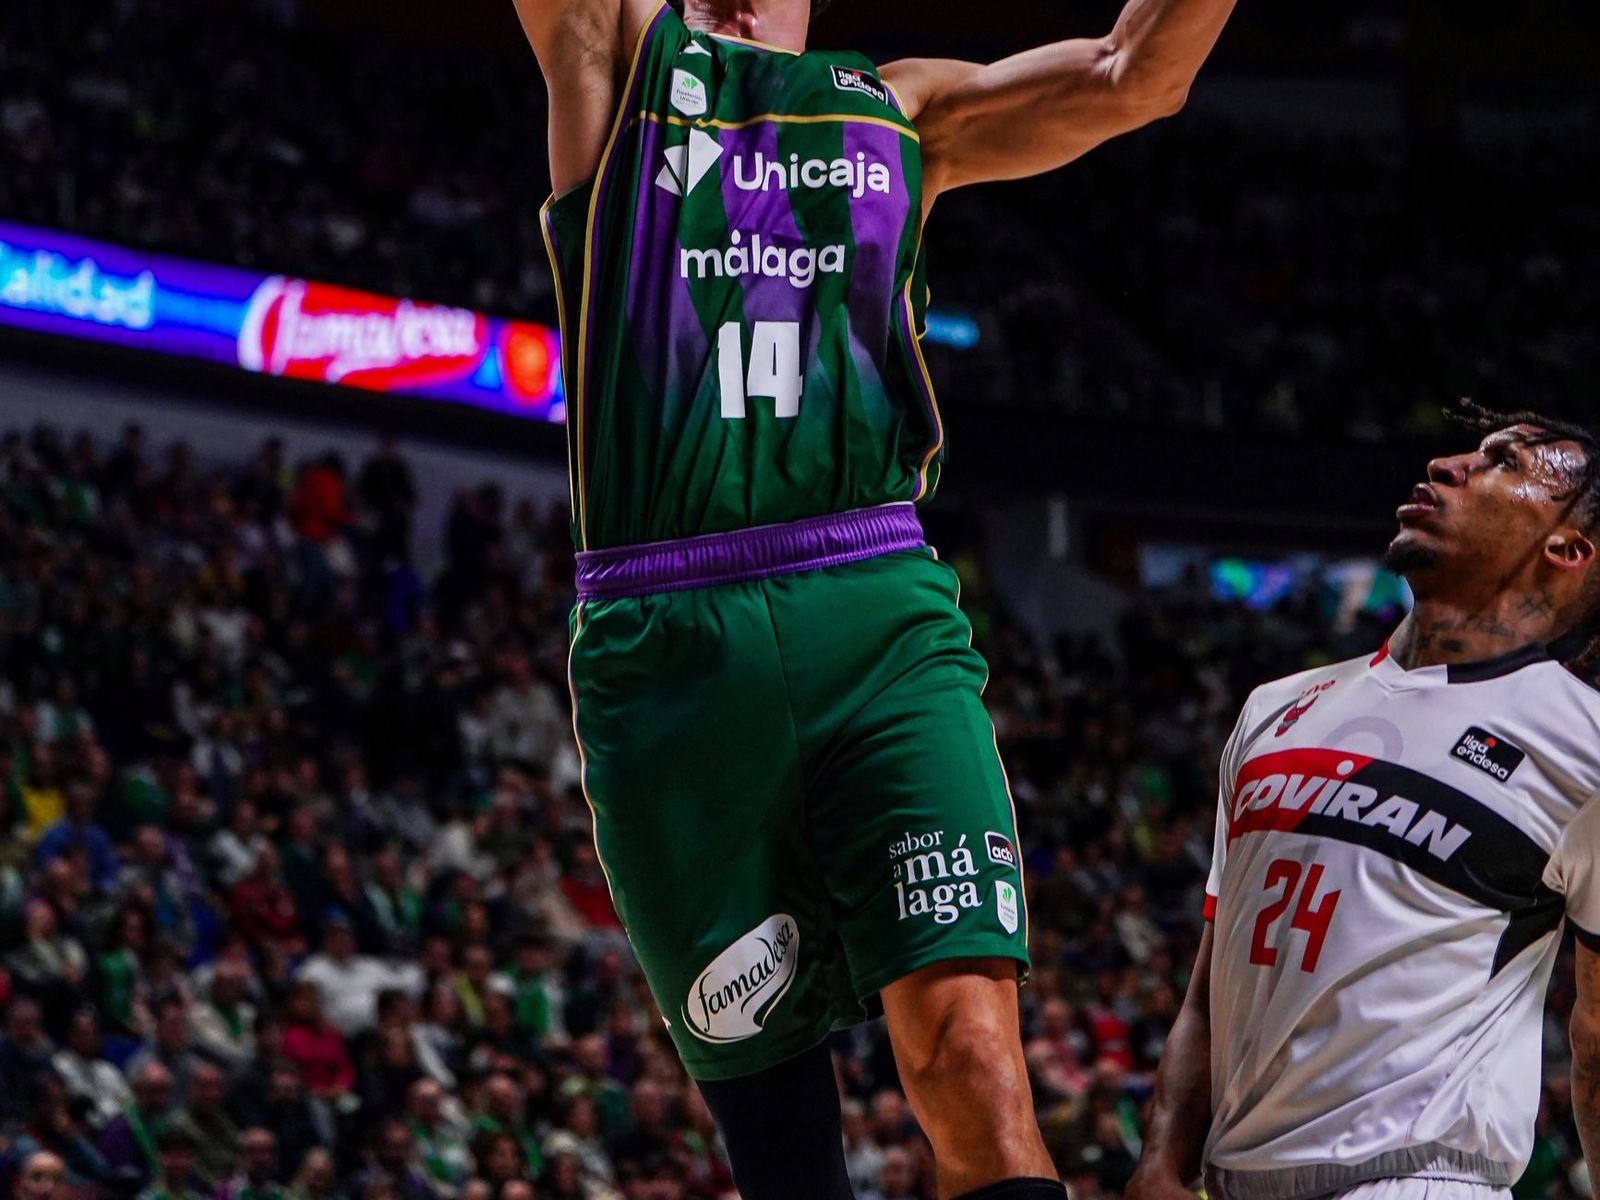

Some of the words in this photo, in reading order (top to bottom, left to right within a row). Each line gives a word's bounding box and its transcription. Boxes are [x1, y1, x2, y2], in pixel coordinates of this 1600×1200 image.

[733, 152, 890, 198] Unicaja
[680, 229, 845, 288] málaga
[717, 321, 803, 418] 14
[1457, 745, 1508, 779] endesa
[1463, 735, 1488, 753] liga
[1234, 760, 1472, 862] COVIRAN
[888, 830, 944, 859] sabor
[904, 833, 980, 885] má
[992, 846, 1013, 862] acb
[894, 880, 983, 924] laga
[1249, 858, 1342, 974] 24
[698, 920, 794, 1032] famadesa
